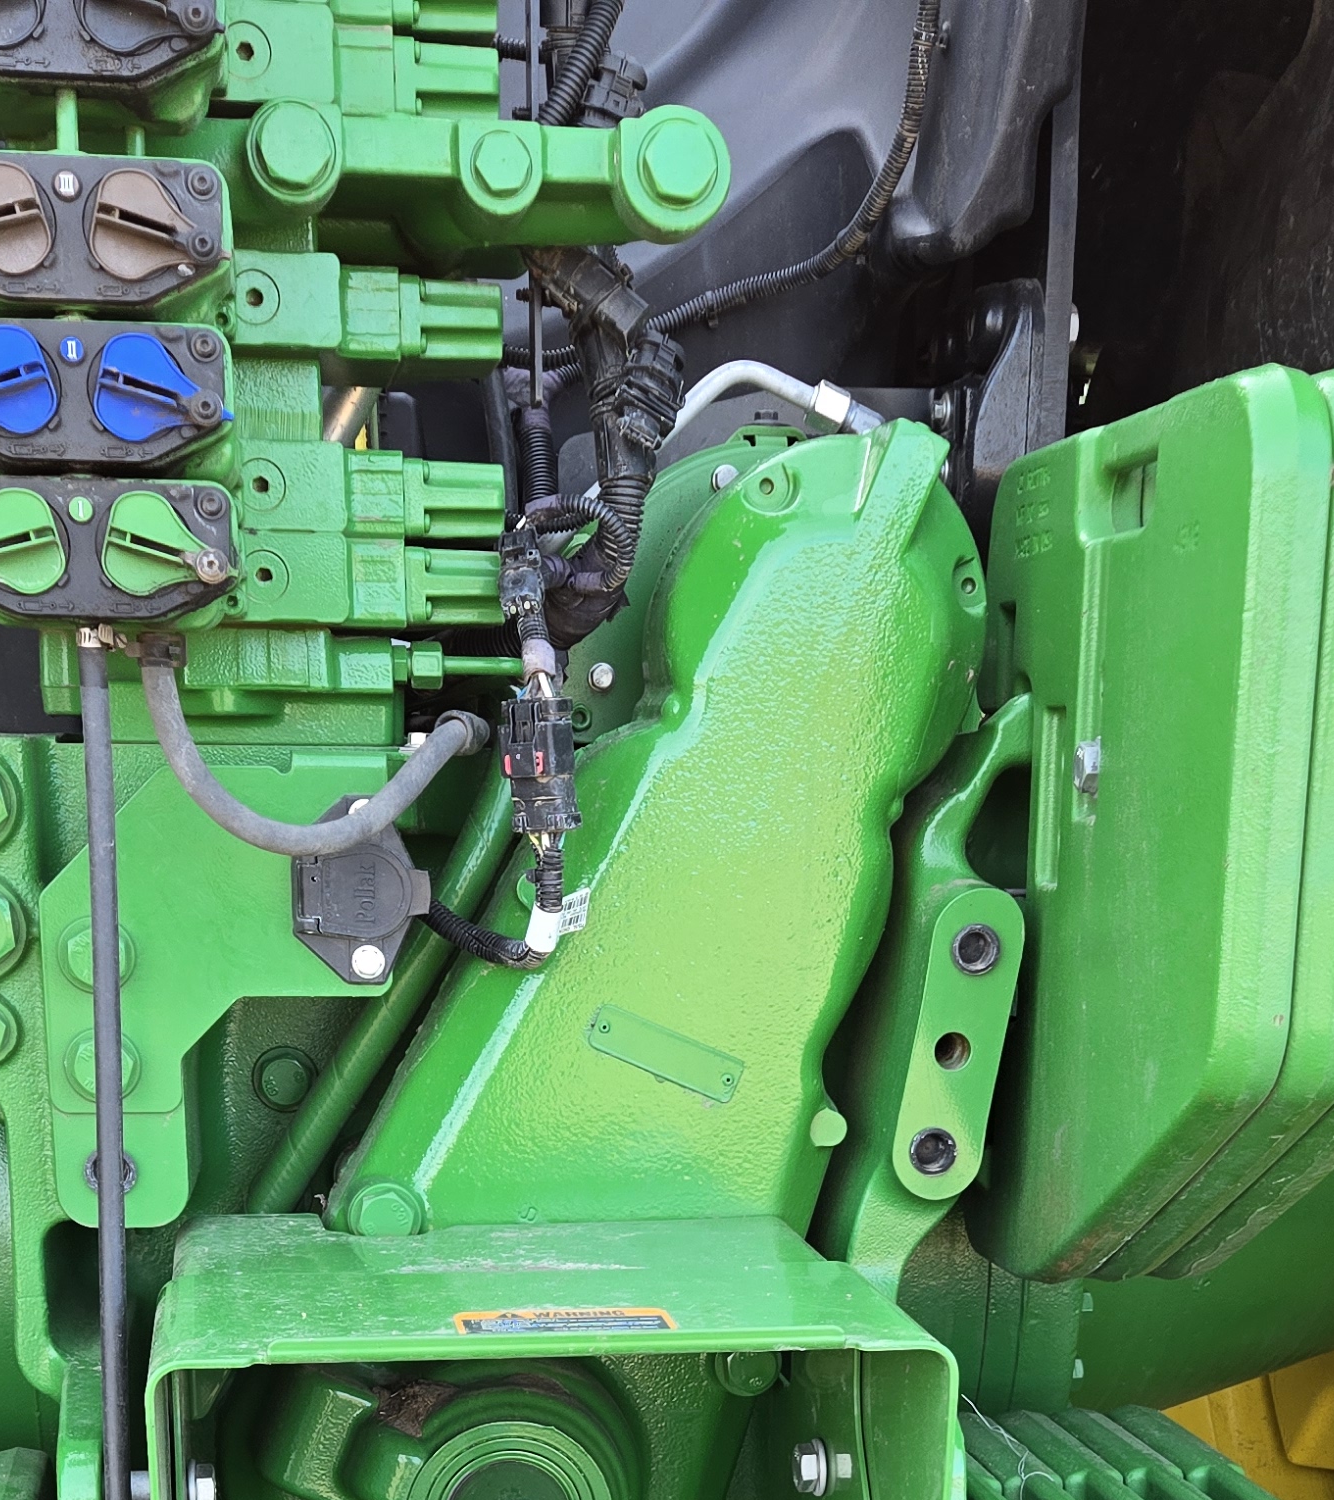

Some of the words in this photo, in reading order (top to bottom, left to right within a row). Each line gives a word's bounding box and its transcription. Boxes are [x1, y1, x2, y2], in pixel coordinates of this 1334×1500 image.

[58, 173, 75, 195] III
[67, 340, 78, 360] II
[354, 861, 376, 924] Pollak
[533, 1309, 625, 1319] WARNING
